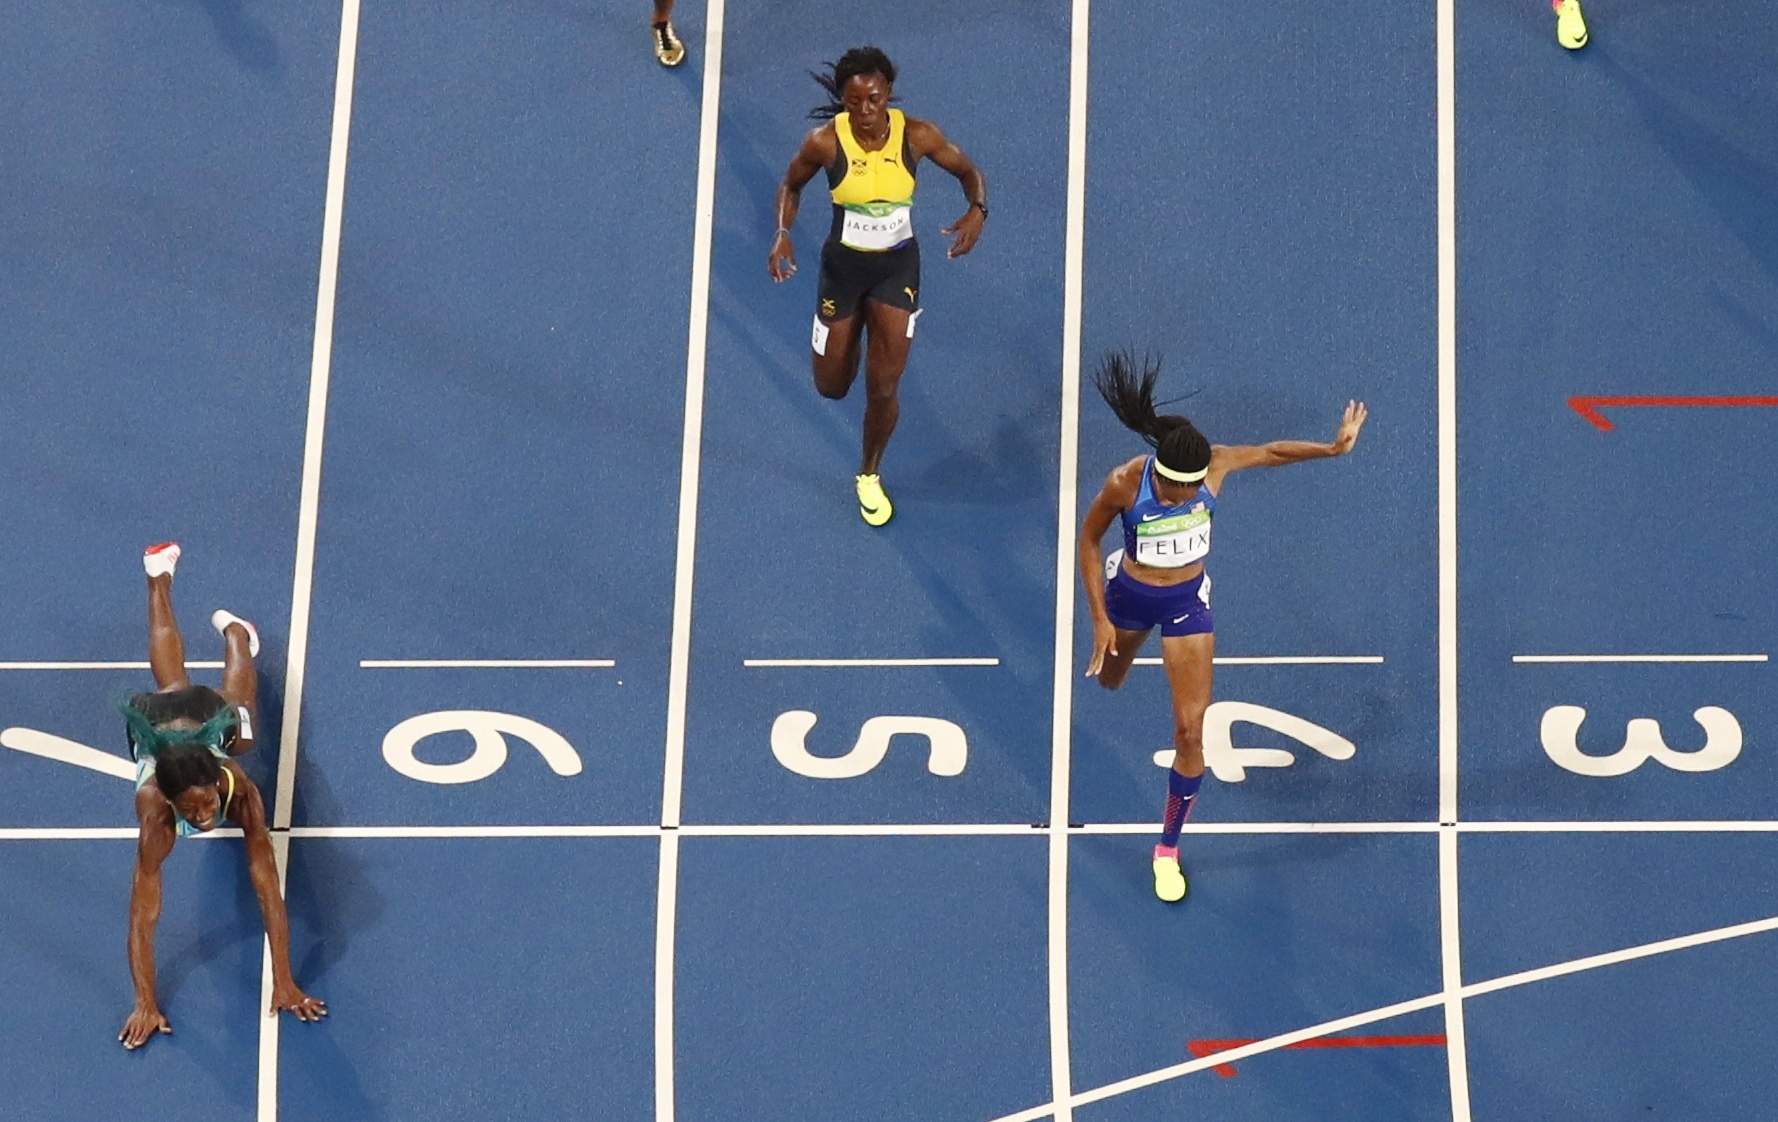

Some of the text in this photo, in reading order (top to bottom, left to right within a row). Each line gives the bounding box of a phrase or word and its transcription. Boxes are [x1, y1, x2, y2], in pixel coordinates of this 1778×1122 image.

[847, 217, 904, 232] JACKSON
[1139, 530, 1209, 555] FELIX
[382, 709, 584, 785] 6
[769, 710, 969, 780] 5
[1153, 701, 1357, 783] 4
[1540, 705, 1743, 777] 3
